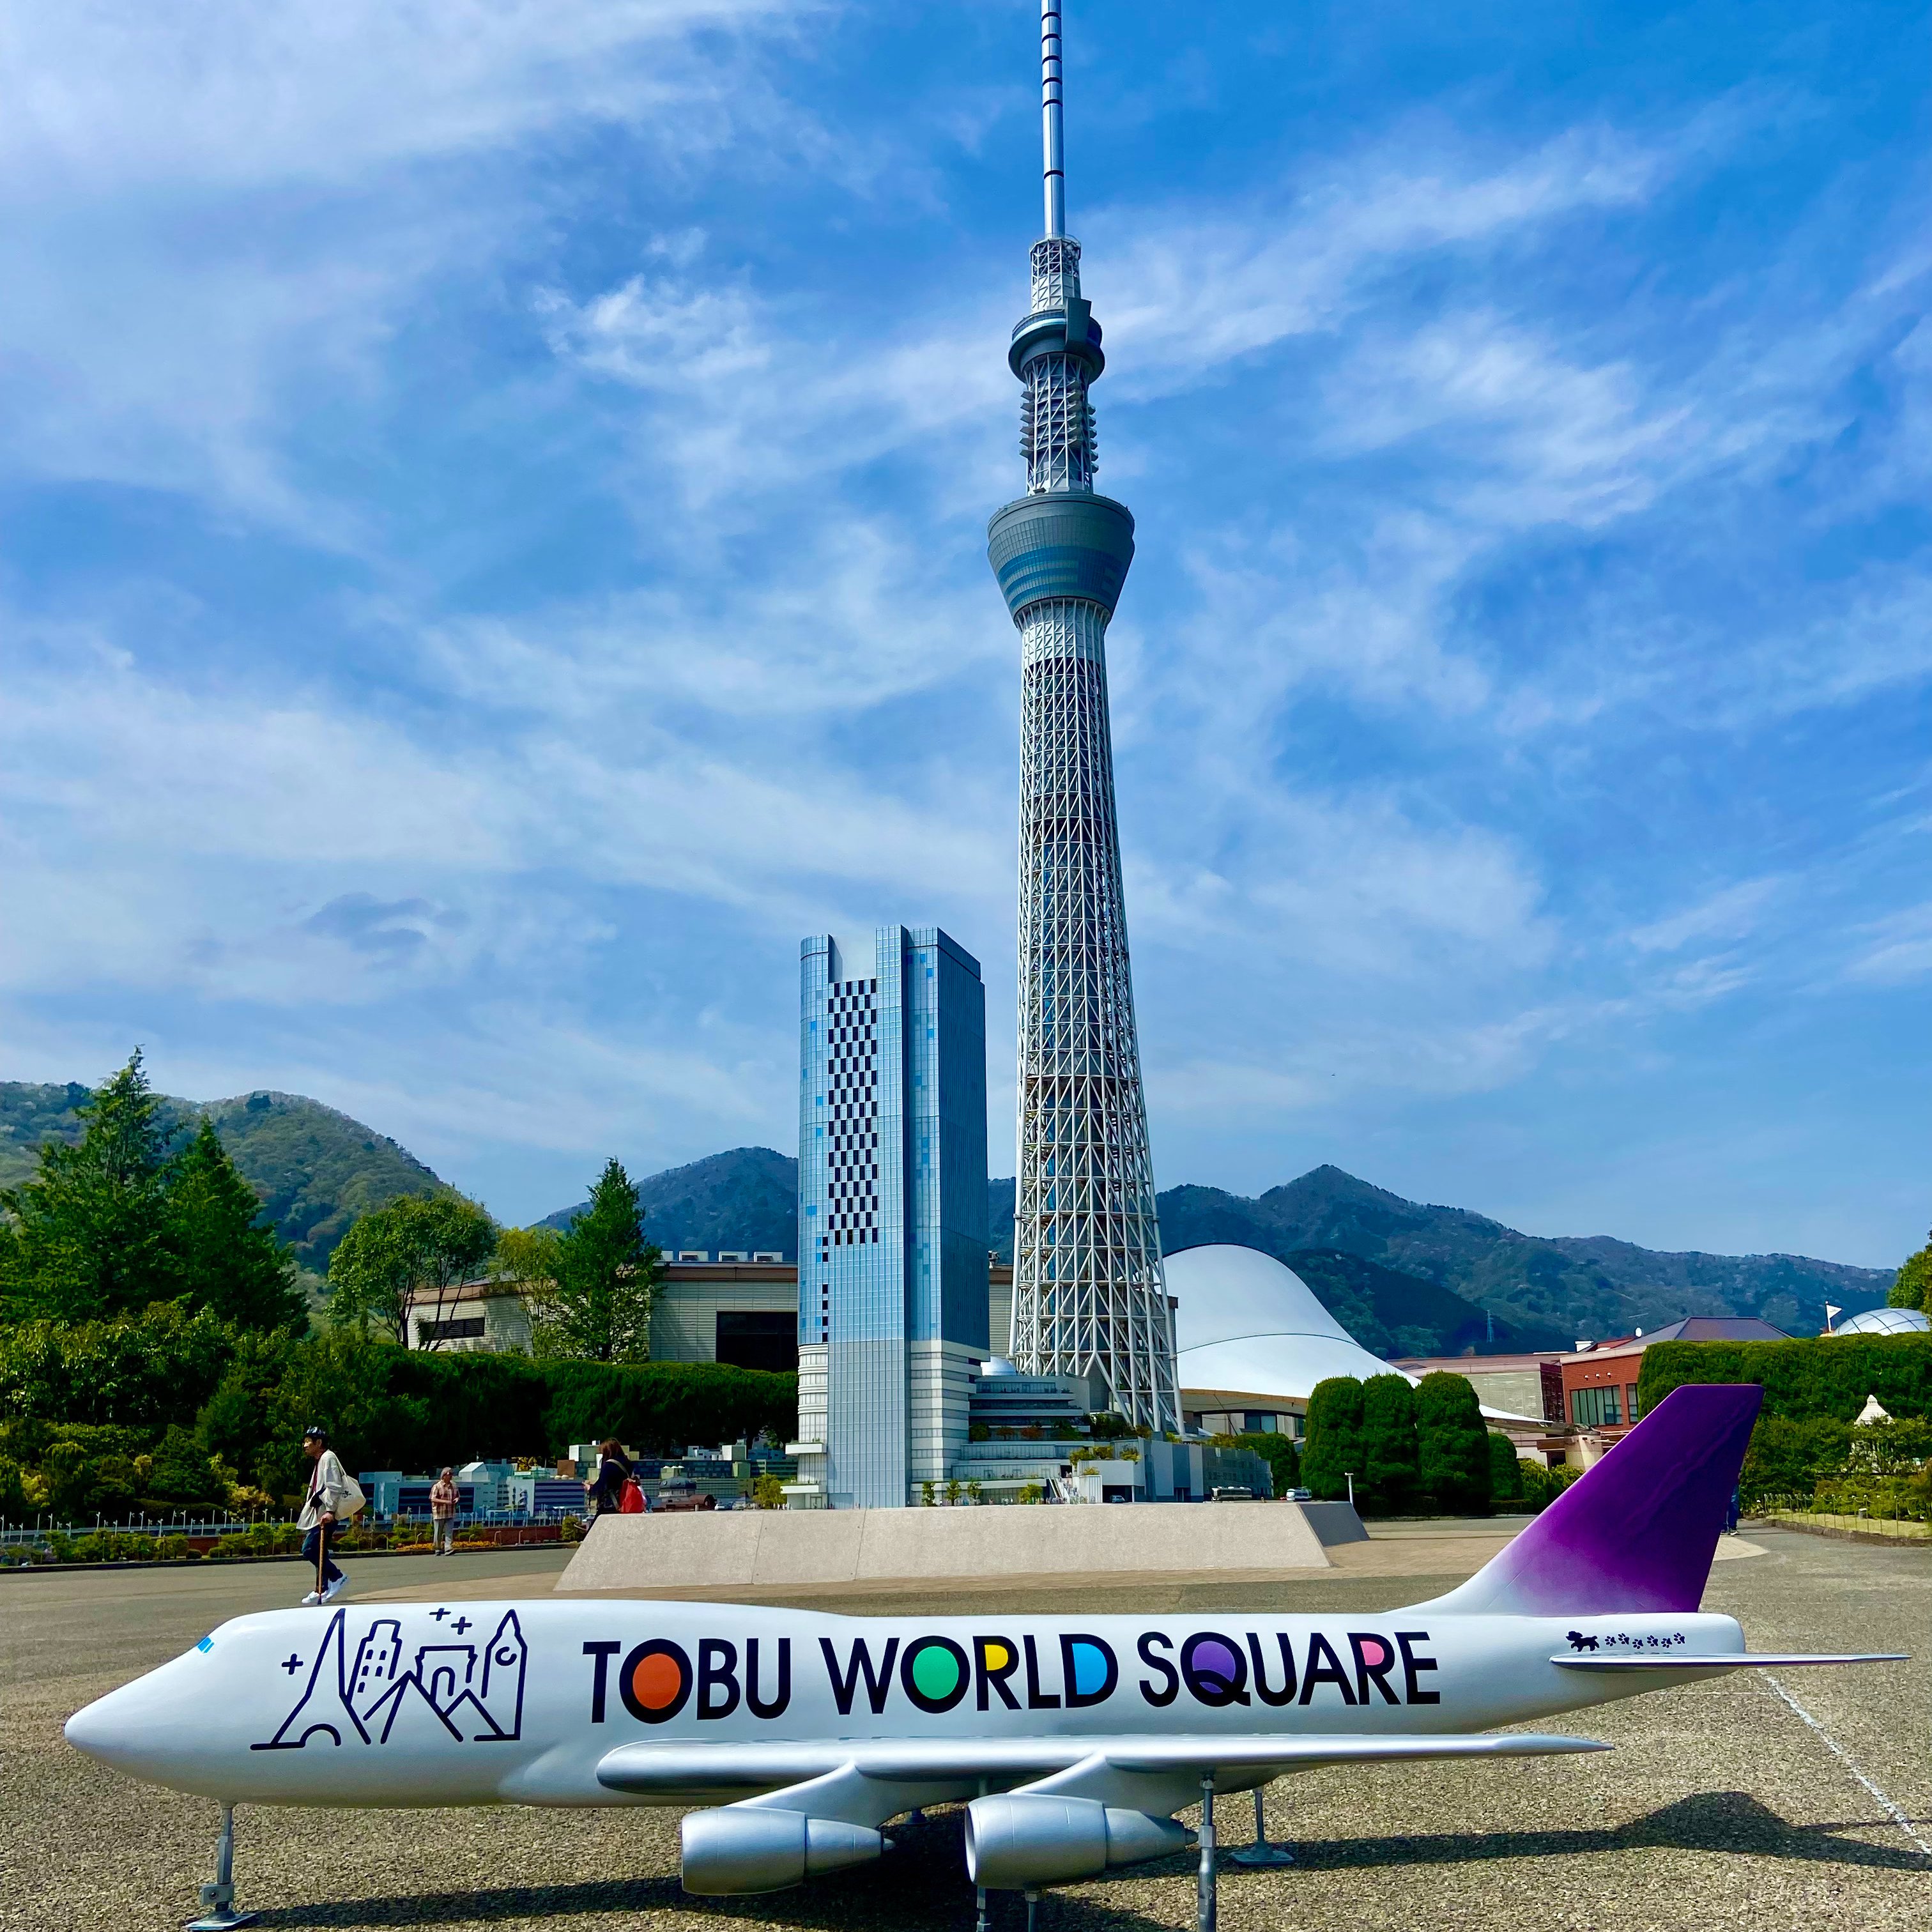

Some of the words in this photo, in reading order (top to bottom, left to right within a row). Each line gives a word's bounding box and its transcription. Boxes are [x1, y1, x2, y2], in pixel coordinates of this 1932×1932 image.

[583, 1638, 790, 1724] TOBU
[818, 1634, 1119, 1715] WORLD
[1137, 1631, 1440, 1708] SQUARE
